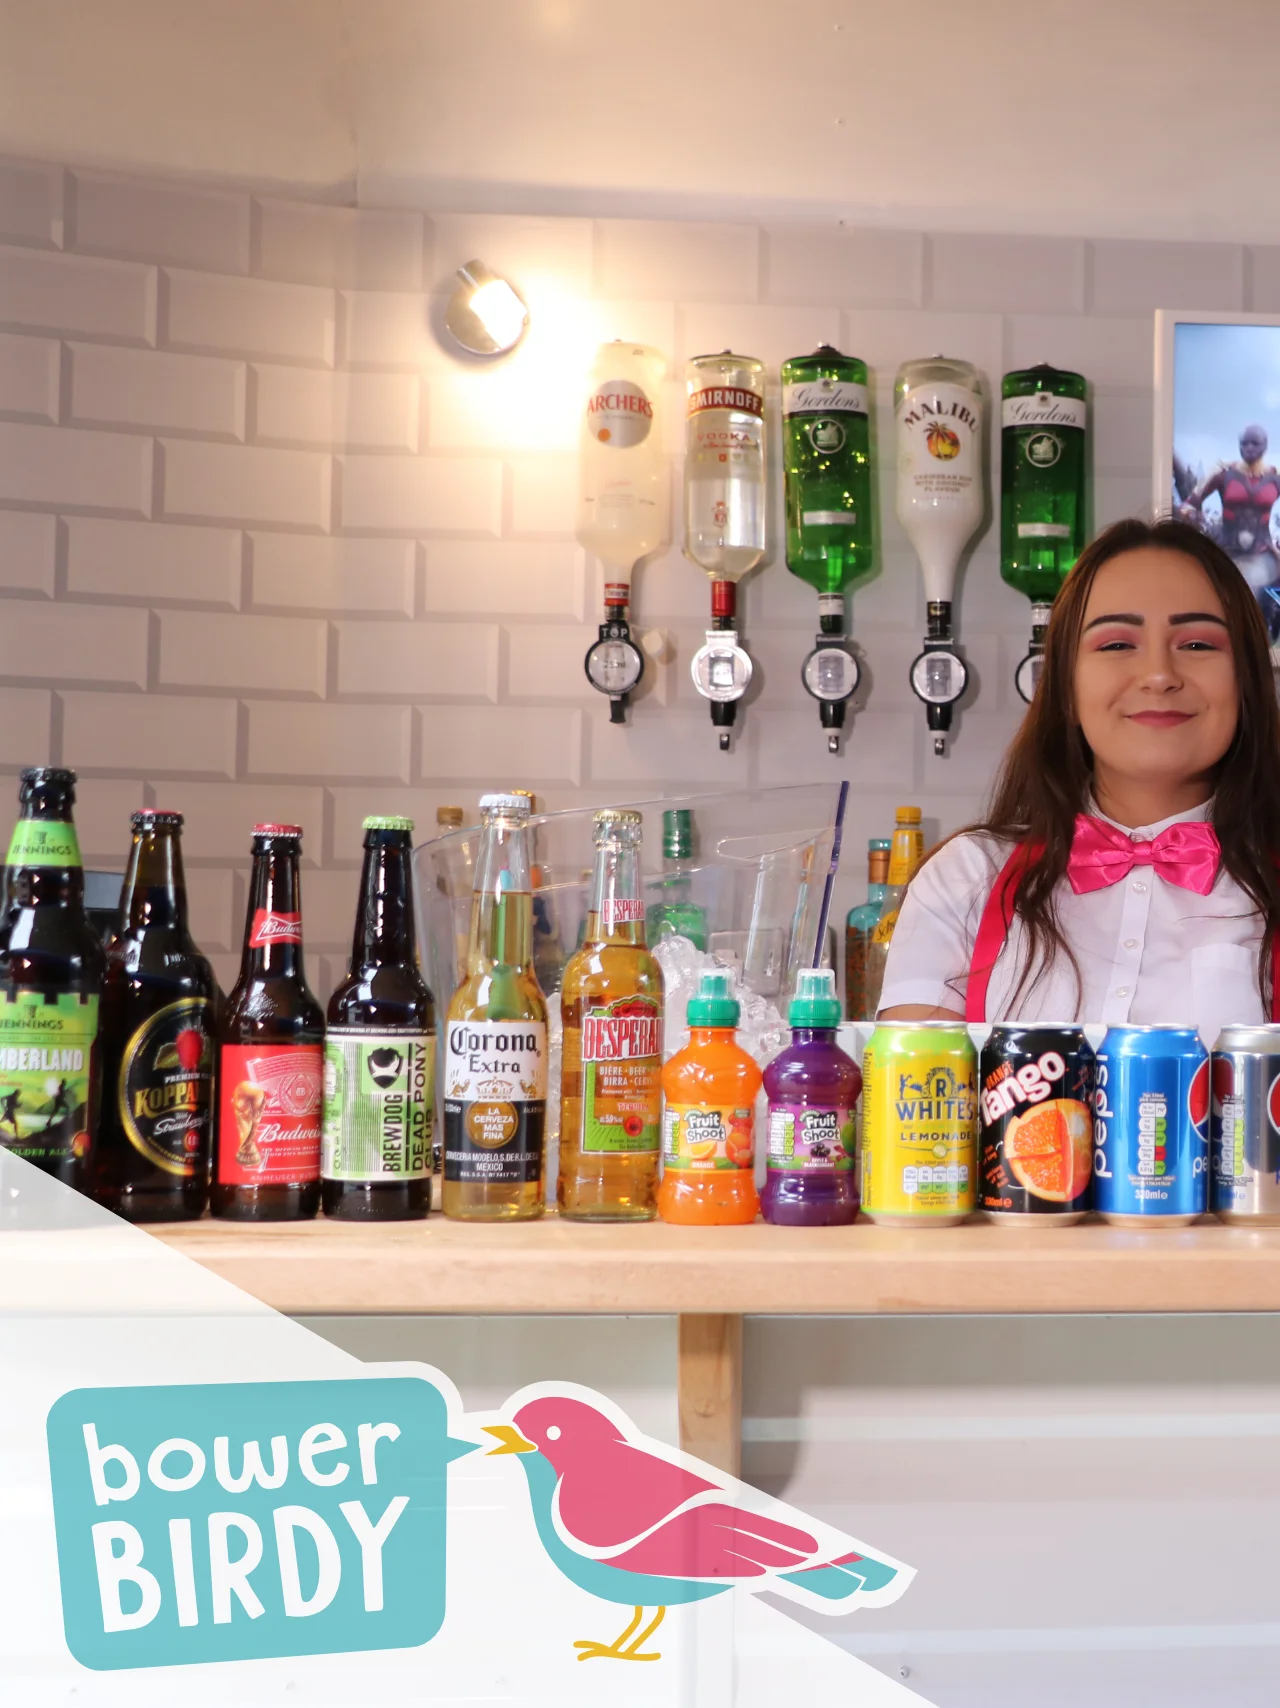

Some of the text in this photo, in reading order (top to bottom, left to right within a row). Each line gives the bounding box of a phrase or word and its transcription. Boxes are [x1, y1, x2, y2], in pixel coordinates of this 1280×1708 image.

[587, 394, 654, 418] ARCHERS
[690, 390, 760, 413] SMIRNOFF
[904, 400, 979, 432] MALIBU
[697, 432, 751, 441] VODKA
[12, 845, 72, 855] JENNINGS
[449, 1025, 539, 1060] Corona
[468, 1053, 521, 1074] Extra
[164, 1072, 200, 1084] PREMIUM
[603, 1076, 628, 1086] BIRRA
[935, 1078, 947, 1098] R
[980, 1051, 1066, 1128] Tango
[412, 1042, 427, 1172] DEAD PONY
[488, 1107, 500, 1115] LA
[474, 1115, 514, 1123] CERVEZA
[688, 1114, 720, 1128] Fruit
[806, 1114, 836, 1129] Fruit
[1095, 1054, 1114, 1179] pepsi
[382, 1094, 403, 1173] BREWDOG
[687, 1128, 724, 1142] Shoot
[804, 1129, 840, 1142] Shoot
[900, 1131, 972, 1141] LEMONADE
[12, 1148, 46, 1156] OLDEN
[476, 1162, 504, 1171] MEXICO
[691, 1161, 715, 1169] ORANGE
